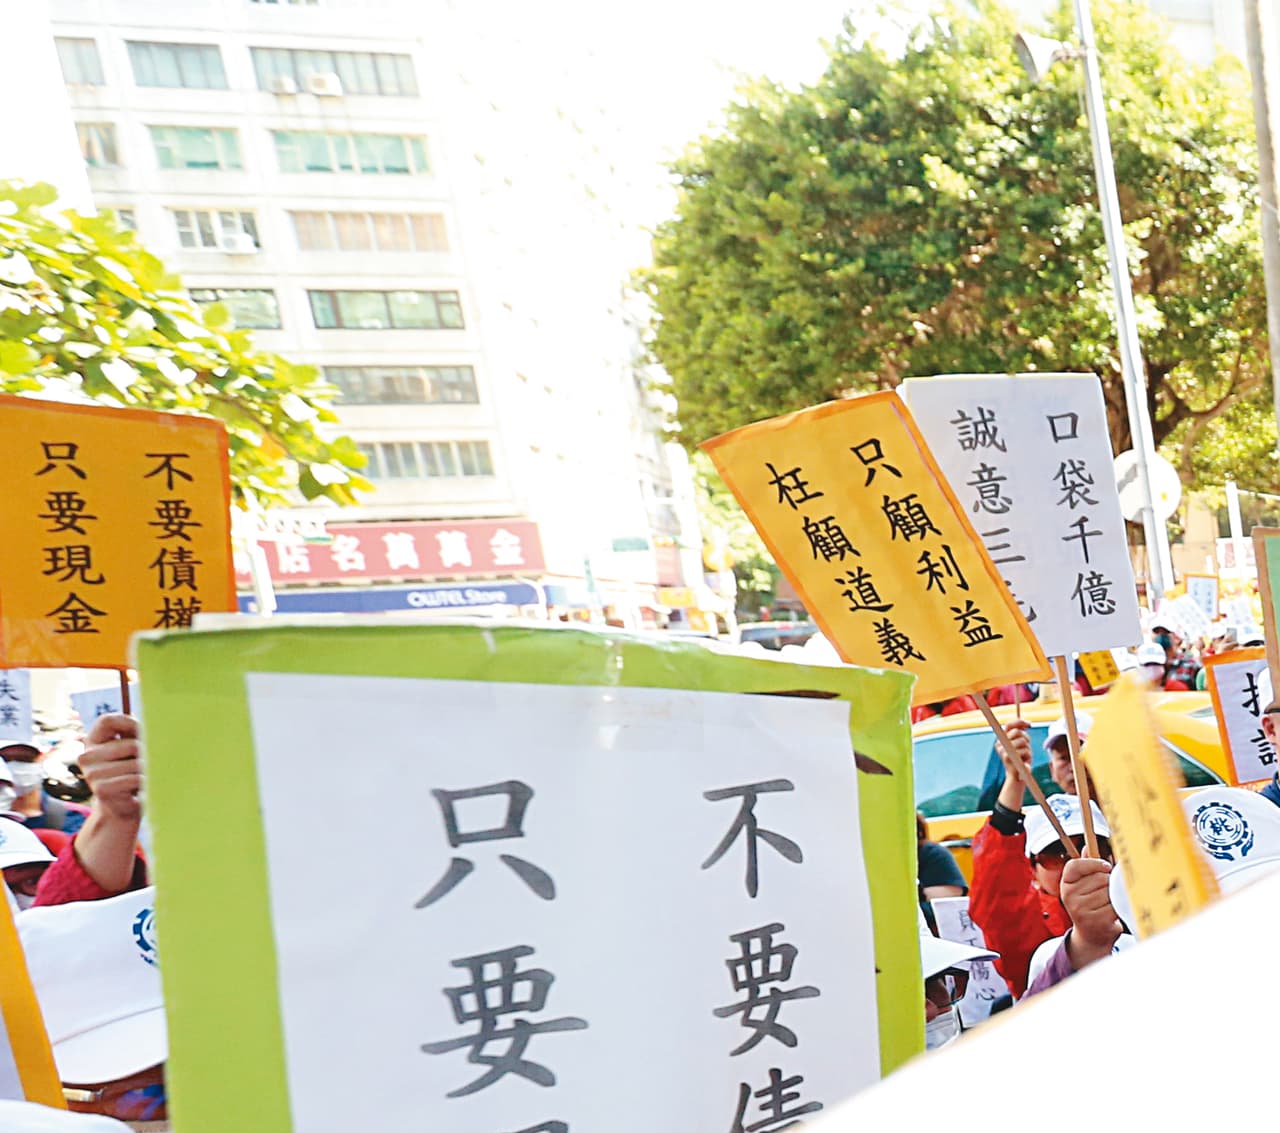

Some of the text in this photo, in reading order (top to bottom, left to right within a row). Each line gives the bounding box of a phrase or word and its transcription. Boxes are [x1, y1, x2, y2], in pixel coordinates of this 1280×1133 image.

[34, 441, 105, 635] 只要現金
[765, 461, 926, 667] 枉顧道義
[849, 437, 1003, 650] 只顧利益
[1046, 411, 1115, 618] 口袋千億
